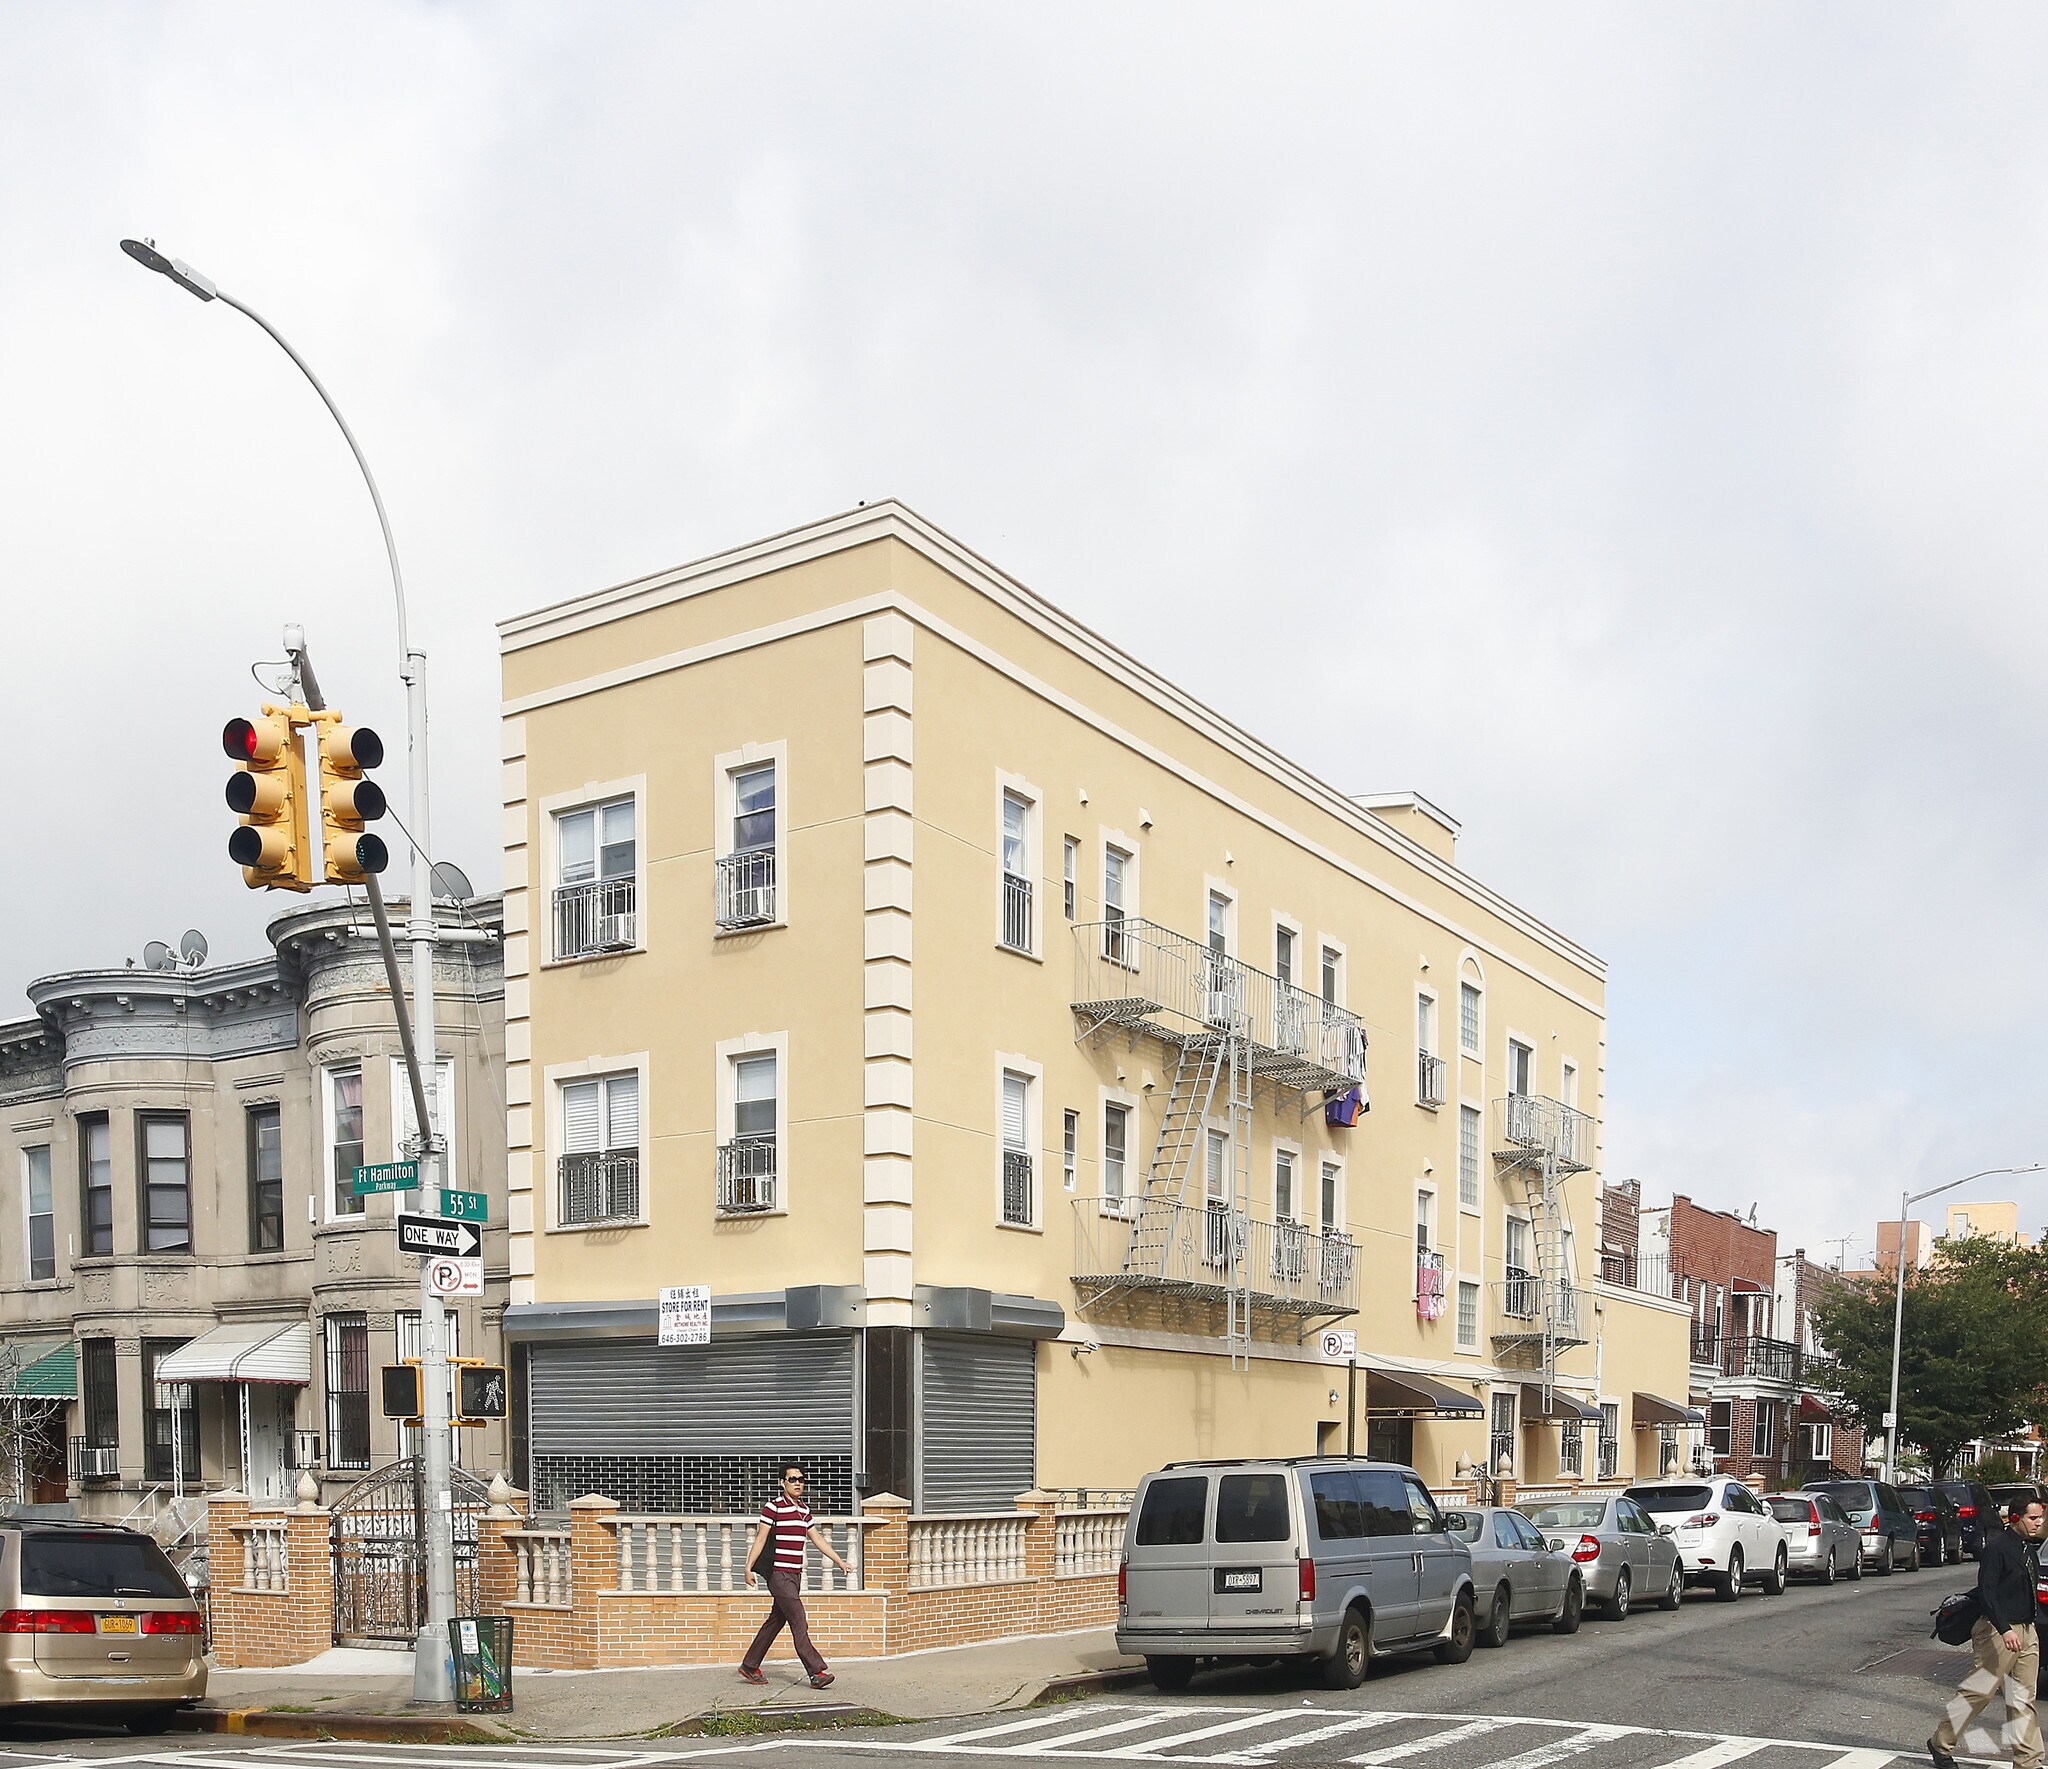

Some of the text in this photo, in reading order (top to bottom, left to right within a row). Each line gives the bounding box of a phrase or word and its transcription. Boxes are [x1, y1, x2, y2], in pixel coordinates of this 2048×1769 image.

[358, 1165, 414, 1183] Ft Hamilton
[375, 1182, 397, 1191] Parkway
[450, 1193, 477, 1216] 55 St
[405, 1227, 459, 1246] ONE WAY
[662, 1299, 708, 1314] STORE FOR RENT
[661, 1333, 707, 1343] 646-302-2786
